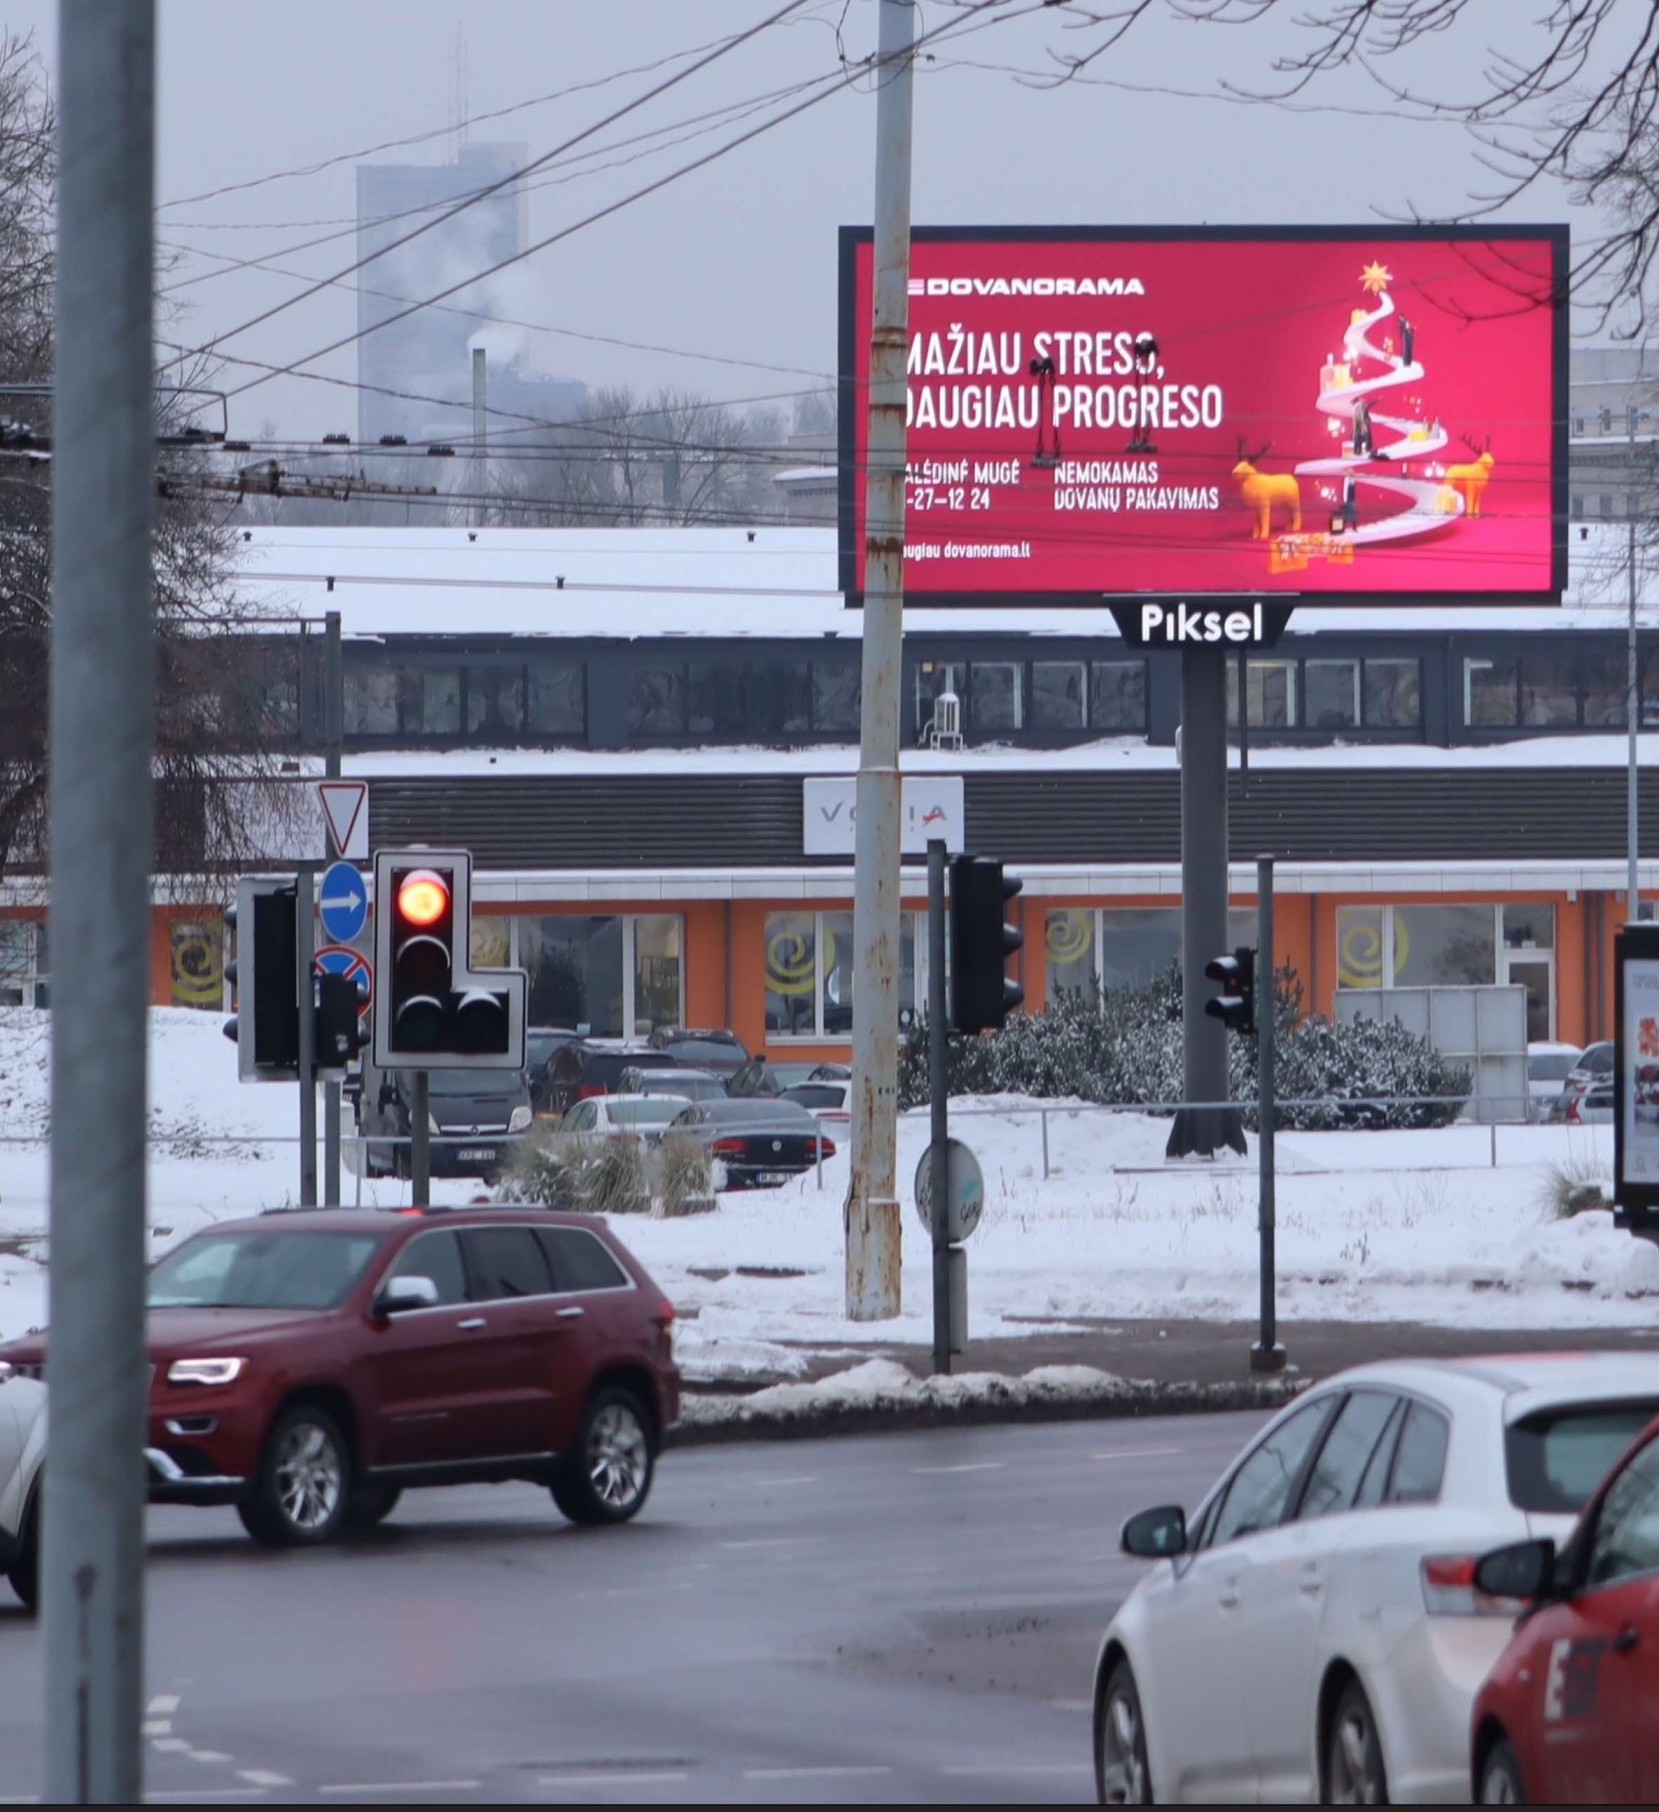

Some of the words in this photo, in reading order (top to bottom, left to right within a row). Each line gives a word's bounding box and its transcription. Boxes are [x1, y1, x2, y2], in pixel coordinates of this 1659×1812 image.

[927, 278, 1145, 295] DOVANORAMA
[1054, 385, 1223, 429] PROGRESO
[904, 458, 968, 484] ALĖDINĖ
[973, 458, 1020, 484] MUGĖ
[1054, 461, 1159, 484] NEMOKAMAS
[970, 487, 990, 510] 24
[1126, 487, 1219, 511] PAKAVIMAS
[903, 542, 940, 561] ugiau
[944, 541, 1031, 558] dovanorama.lt
[1140, 603, 1263, 643] Piksel
